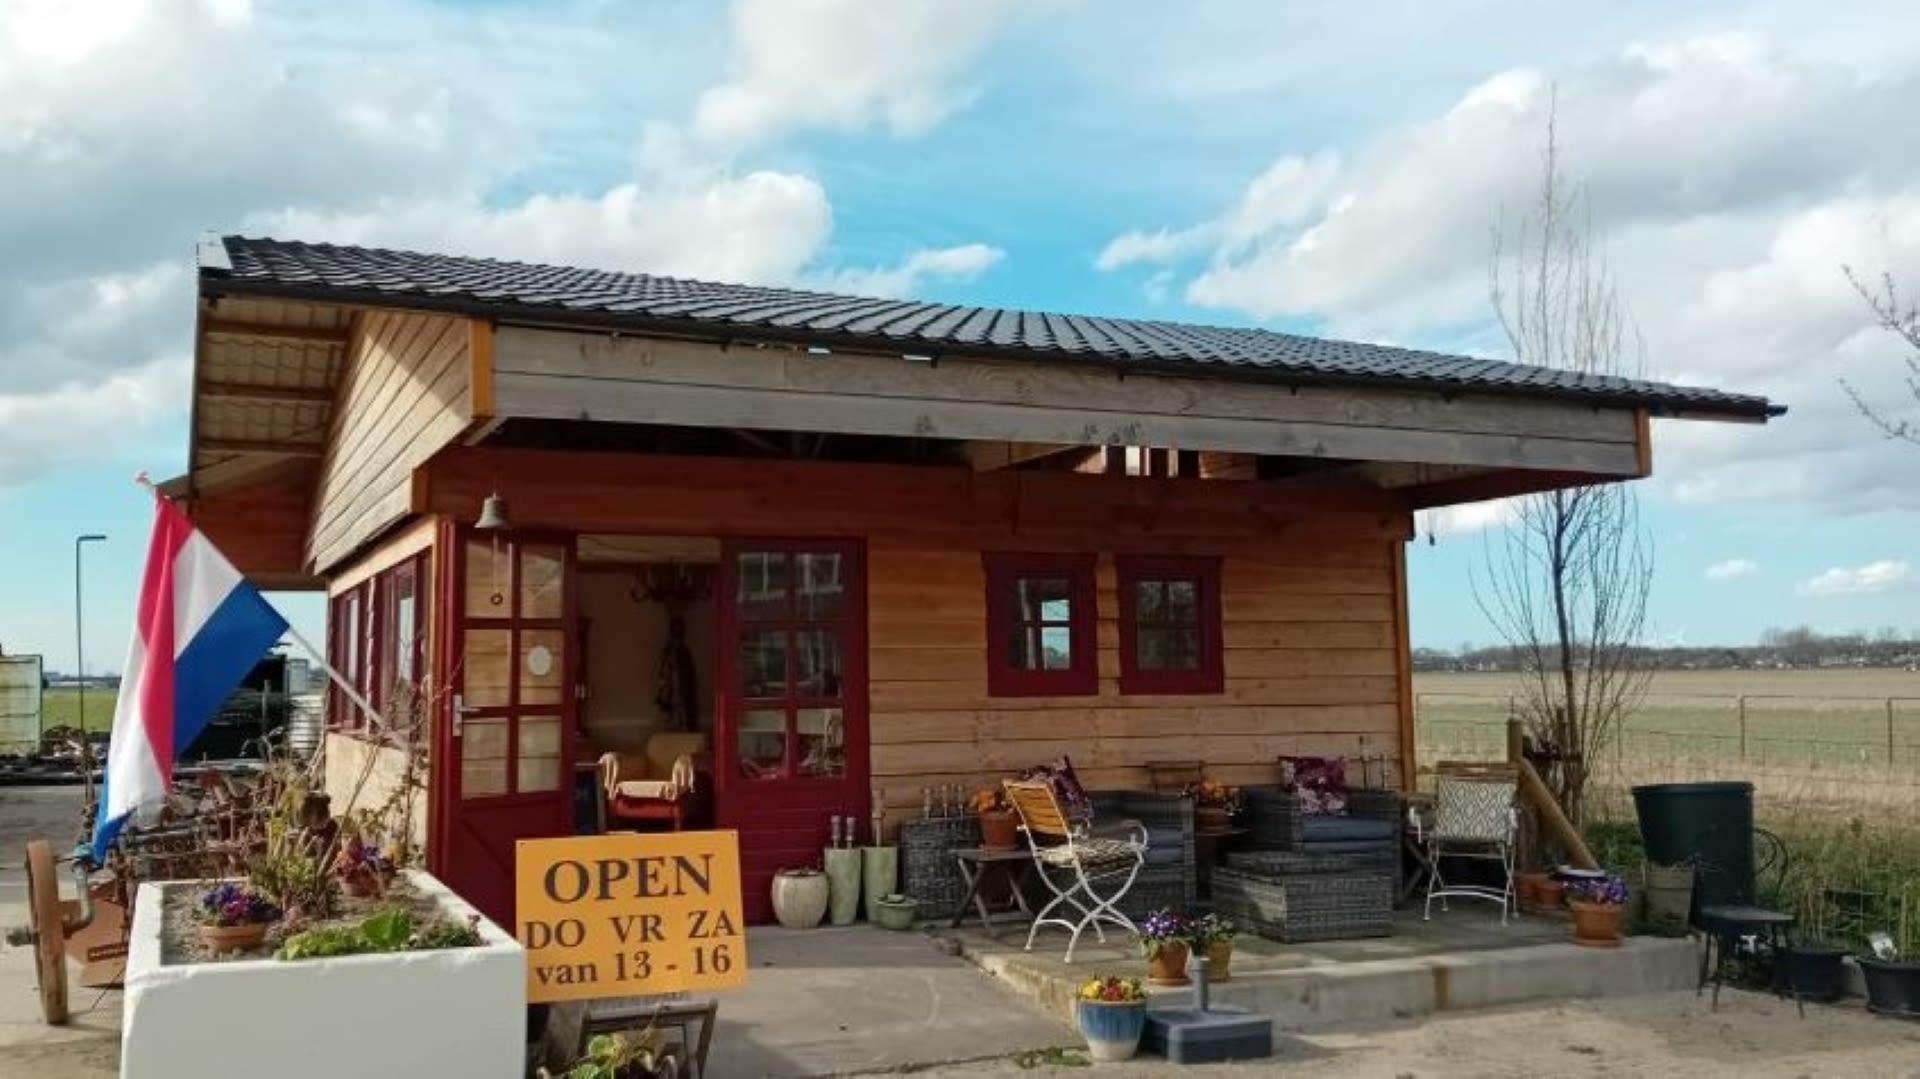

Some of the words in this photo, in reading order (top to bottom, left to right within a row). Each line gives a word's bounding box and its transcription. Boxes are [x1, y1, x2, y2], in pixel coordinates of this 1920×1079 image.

[544, 854, 715, 903] OPEN
[524, 919, 586, 949] DO
[609, 914, 665, 943] VR
[687, 909, 736, 938] ZA
[534, 961, 598, 986] van
[615, 951, 652, 982] 13
[693, 944, 731, 975] 16
